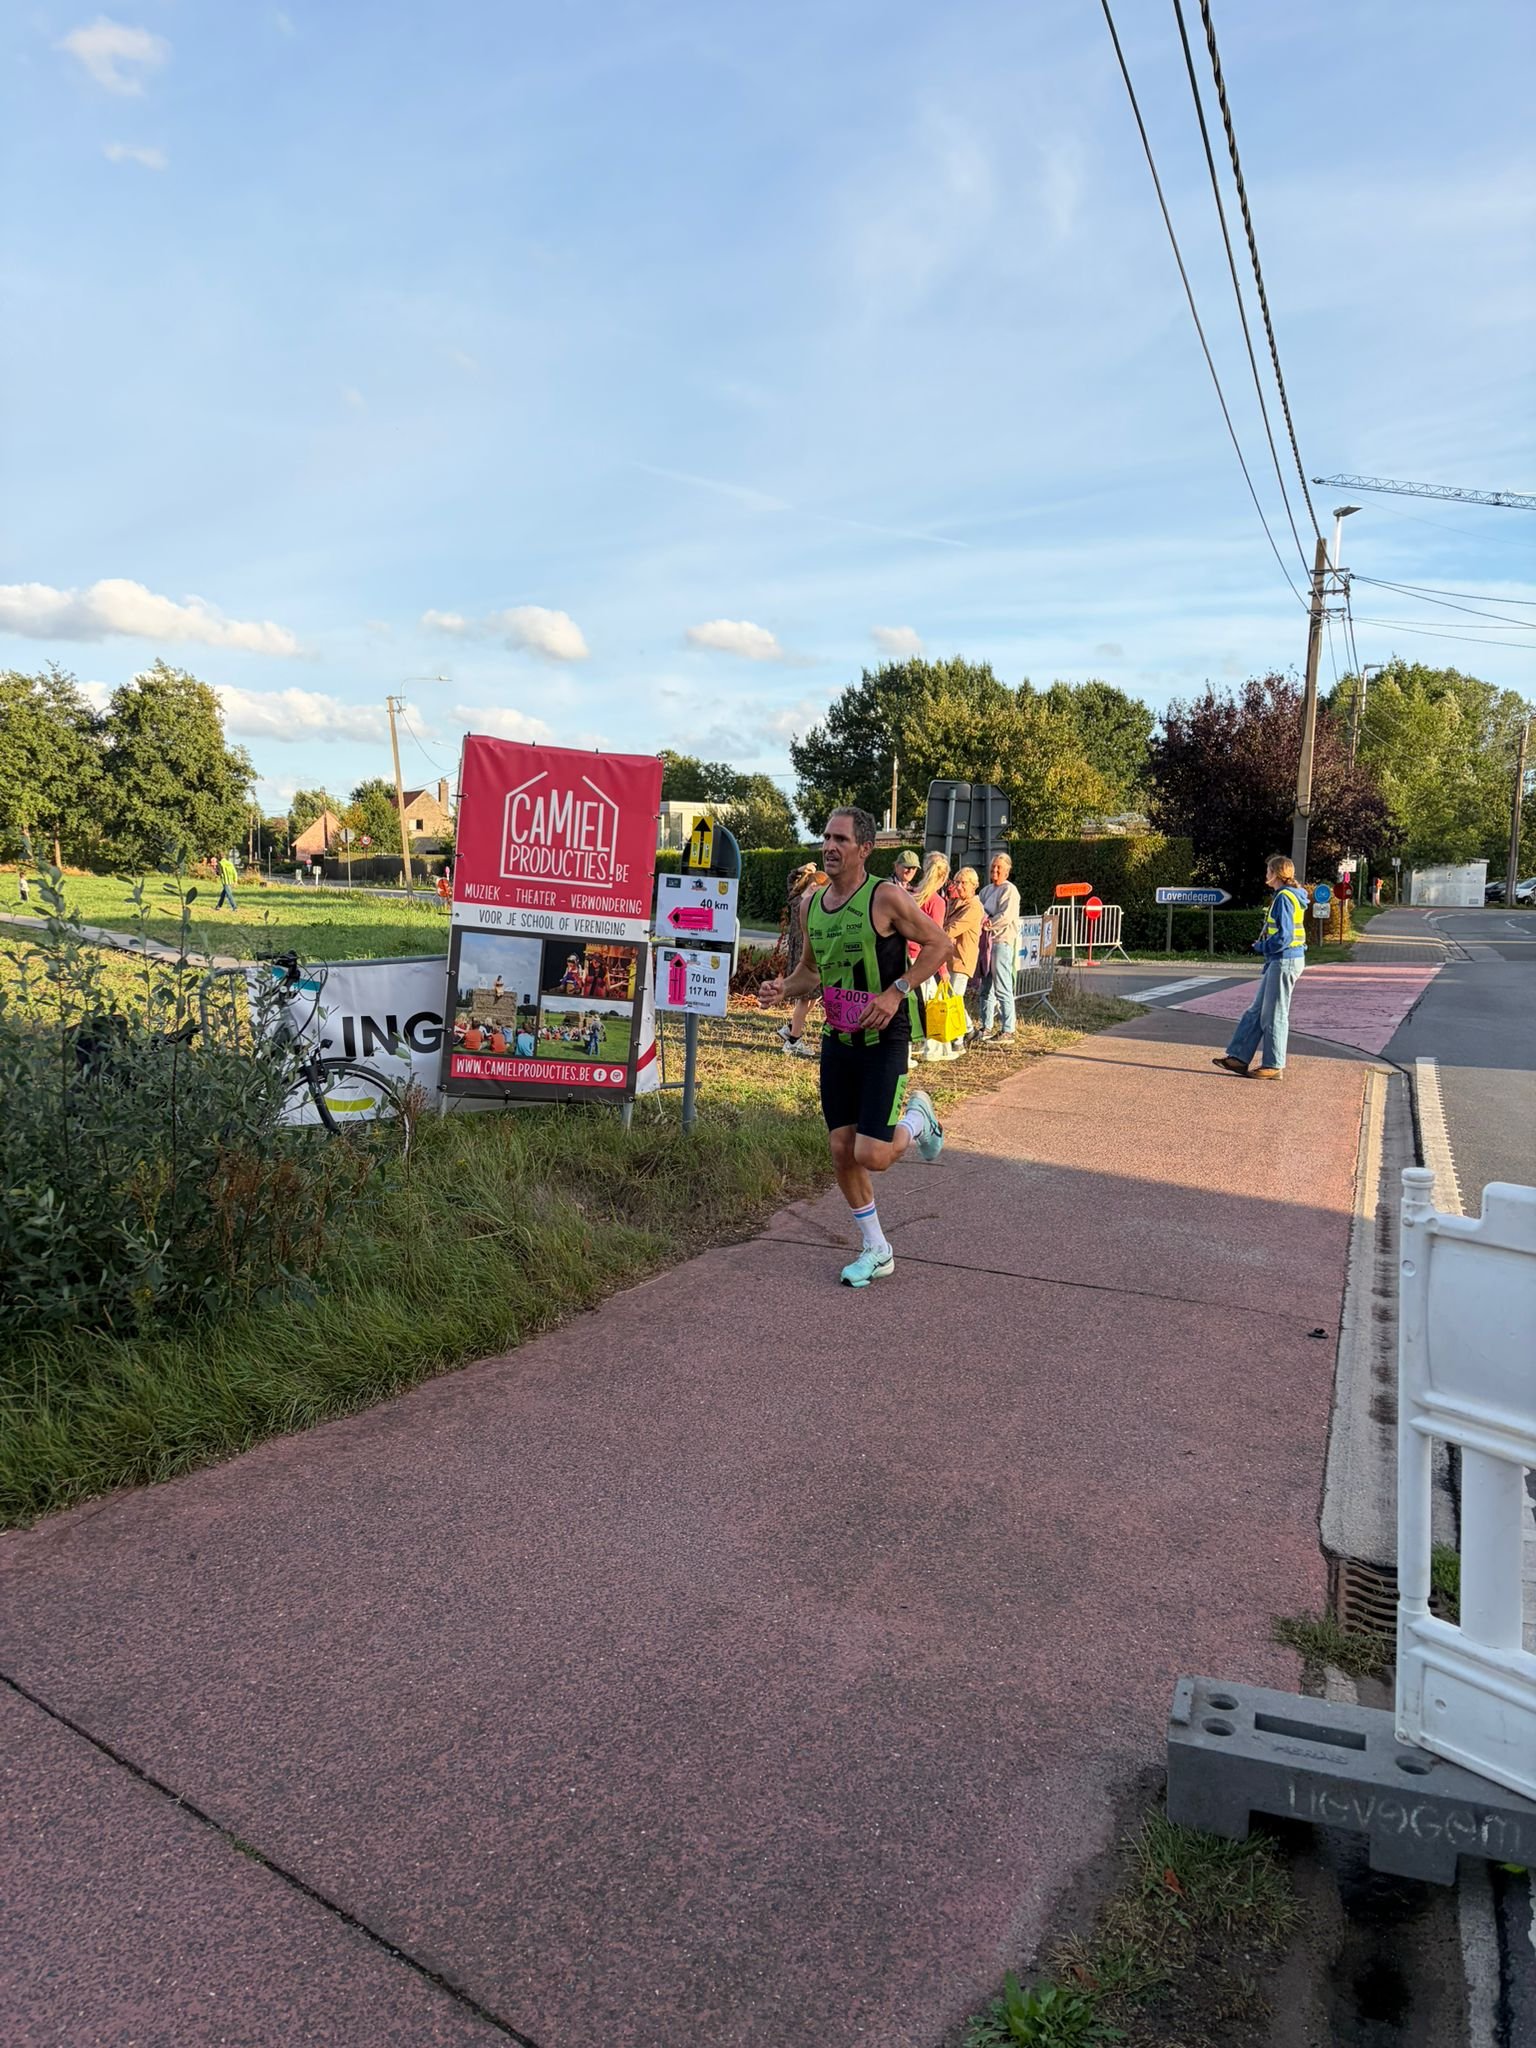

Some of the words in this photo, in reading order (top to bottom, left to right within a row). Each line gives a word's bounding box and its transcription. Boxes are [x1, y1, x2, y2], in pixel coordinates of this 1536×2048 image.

[511, 789, 610, 852] CAMIEL
[464, 883, 501, 901] MUZIEK
[515, 887, 557, 906] THEATER
[570, 894, 643, 914] VERWONDERING
[700, 898, 713, 909] 40
[714, 900, 729, 911] km
[1162, 890, 1217, 903] Lovendegem
[479, 909, 503, 924] VOOR
[506, 913, 518, 926] JE
[521, 913, 555, 930] SCHOOL
[559, 917, 571, 931] OF
[574, 918, 626, 936] VERENIGING
[690, 973, 701, 983] 70
[702, 974, 716, 984] km
[688, 986, 703, 996] 117
[703, 987, 717, 998] km
[834, 988, 869, 1004] 2-009
[342, 1011, 444, 1057] ING
[455, 1057, 592, 1082] WWW.CAMIELPRODUCTIES.BE
